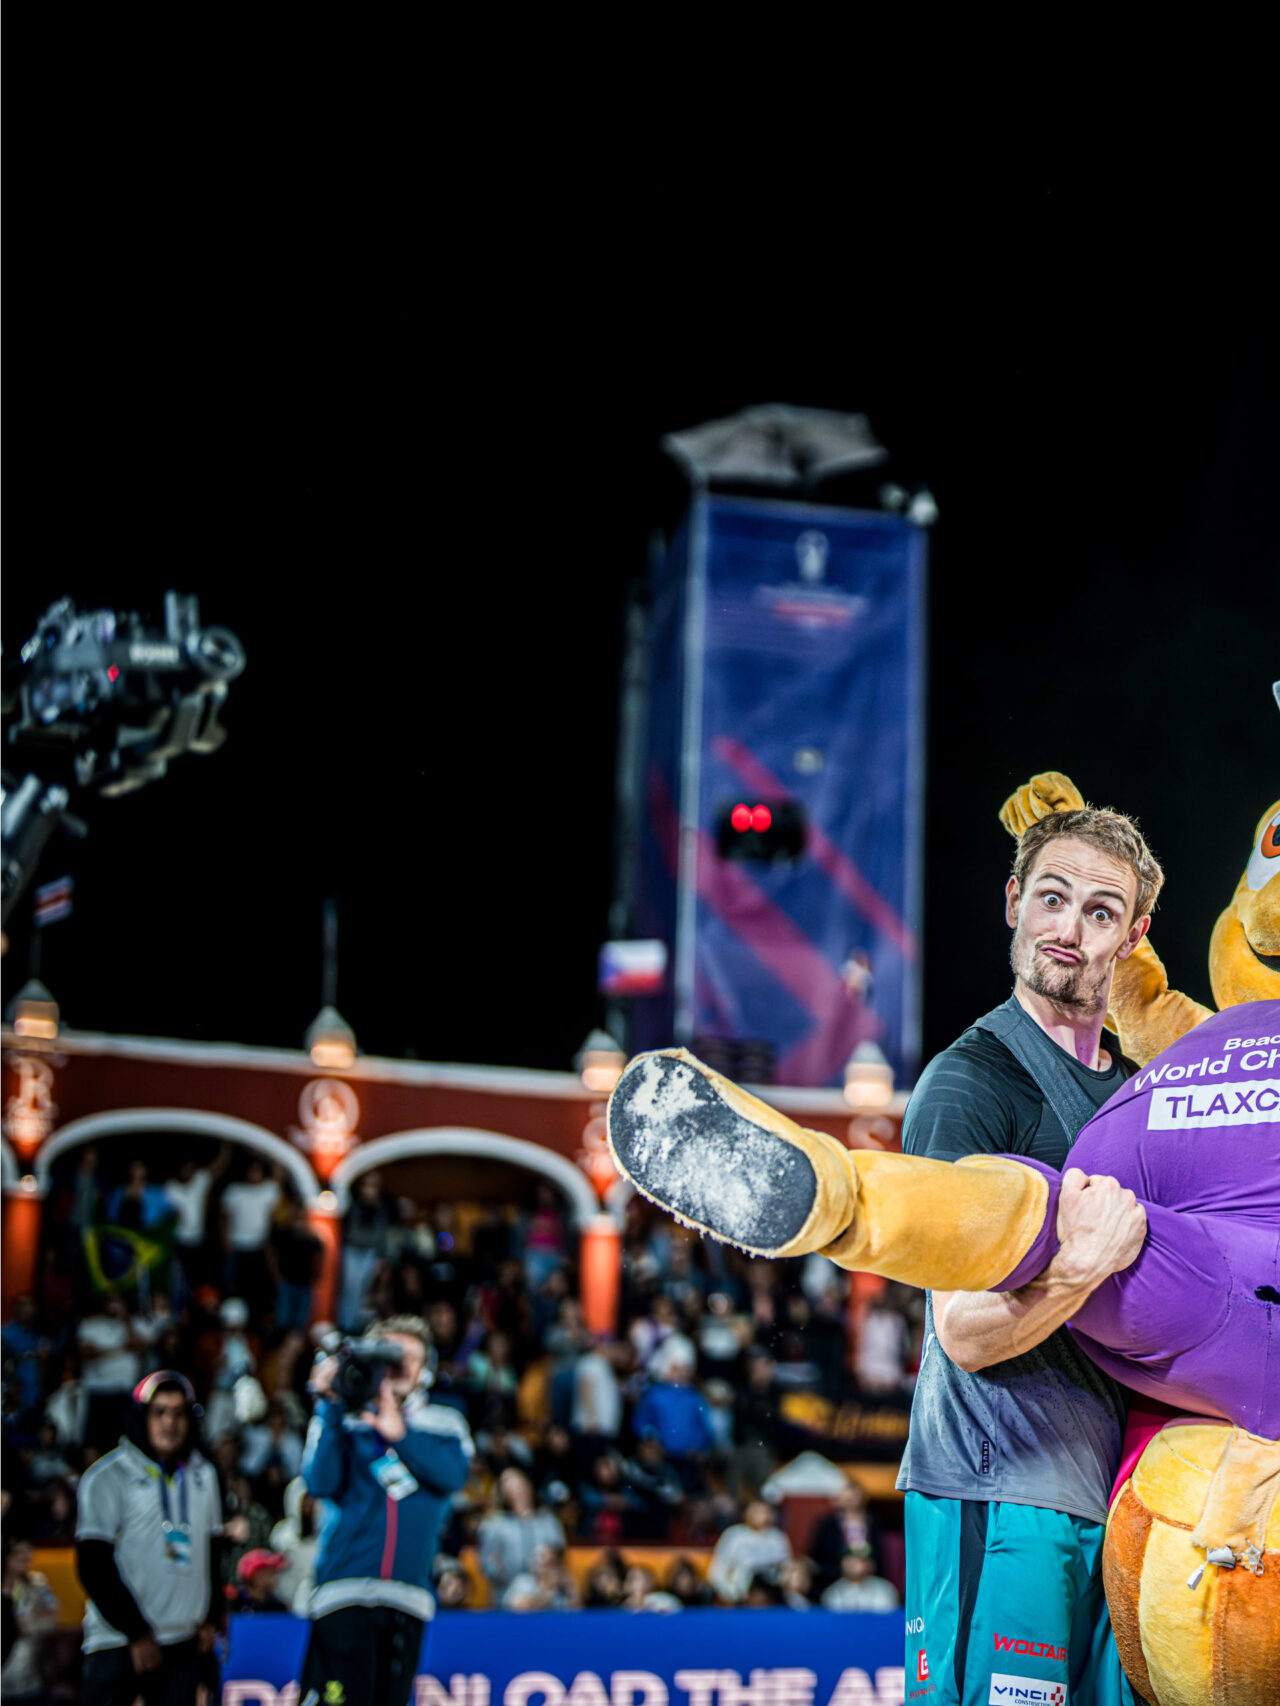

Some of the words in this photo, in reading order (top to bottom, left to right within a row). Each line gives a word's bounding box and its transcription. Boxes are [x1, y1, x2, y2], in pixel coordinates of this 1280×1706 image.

[1134, 1054, 1231, 1092] World
[905, 1617, 925, 1636] NIQ
[994, 1685, 1048, 1702] VINCI
